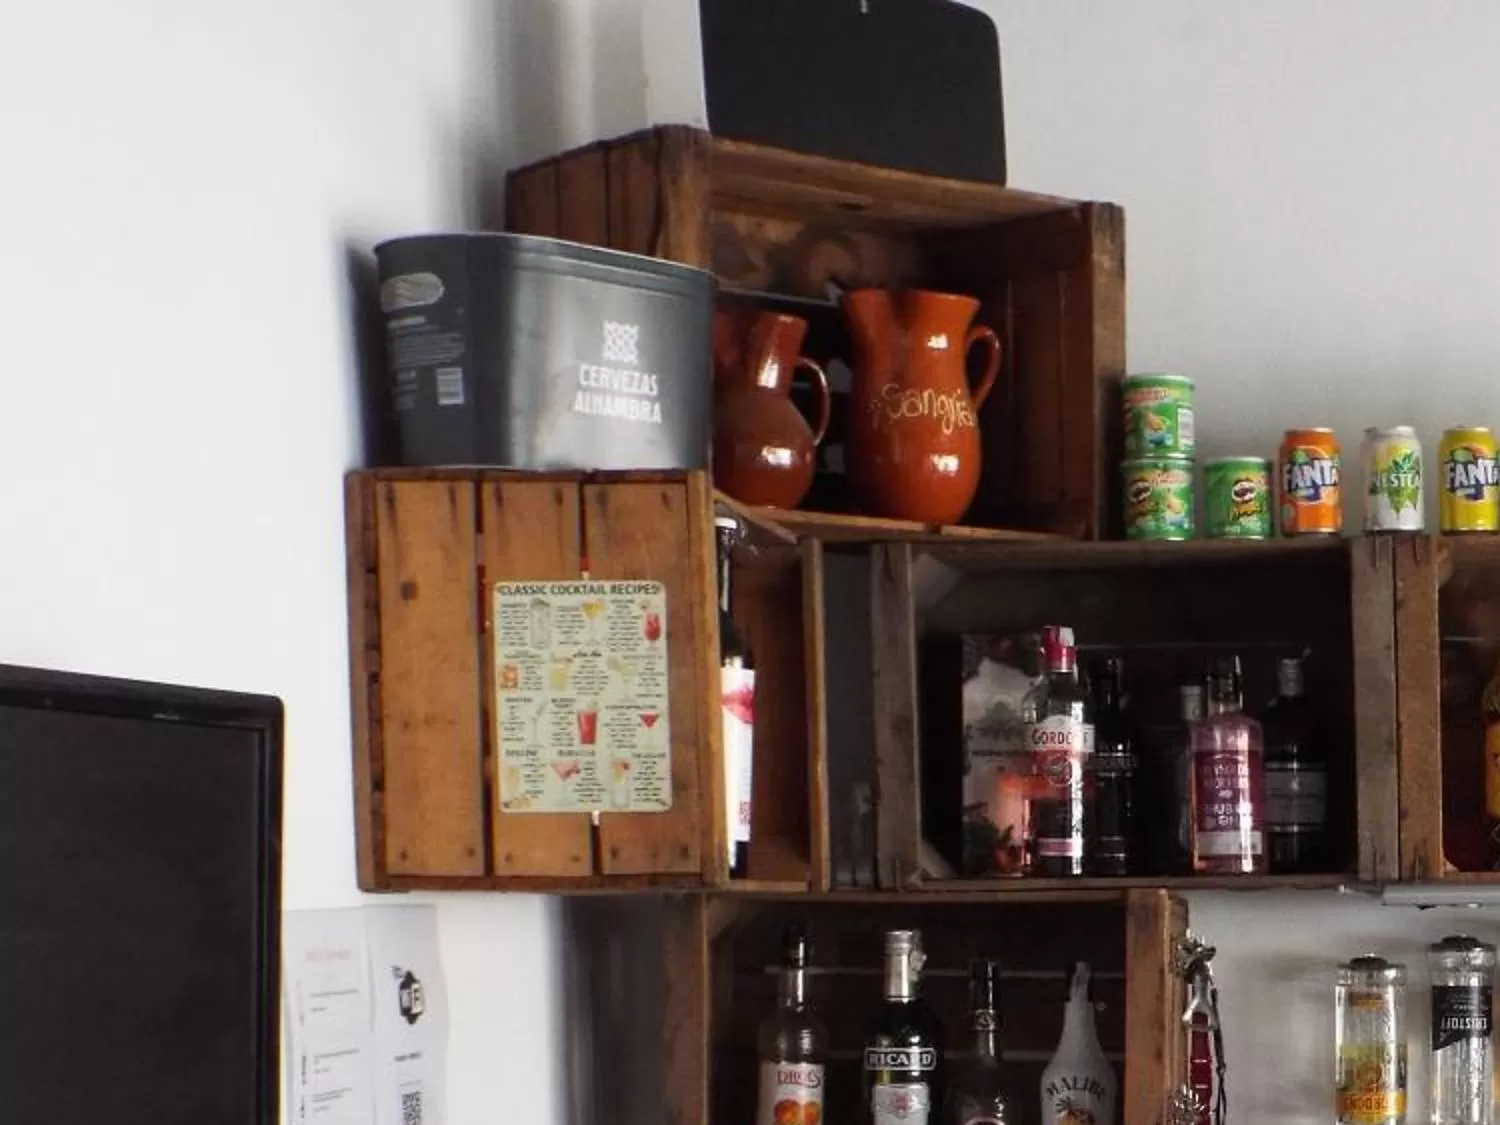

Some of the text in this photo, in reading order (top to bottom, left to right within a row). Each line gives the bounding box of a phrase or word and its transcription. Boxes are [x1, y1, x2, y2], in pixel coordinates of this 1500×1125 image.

[579, 363, 659, 397] CERVEZAS
[574, 391, 662, 424] ALHAMBRA
[1283, 459, 1339, 492] FANTA
[500, 583, 547, 596] CLASSIC
[550, 583, 607, 596] COCKTAIL
[868, 1053, 933, 1066] RICARD
